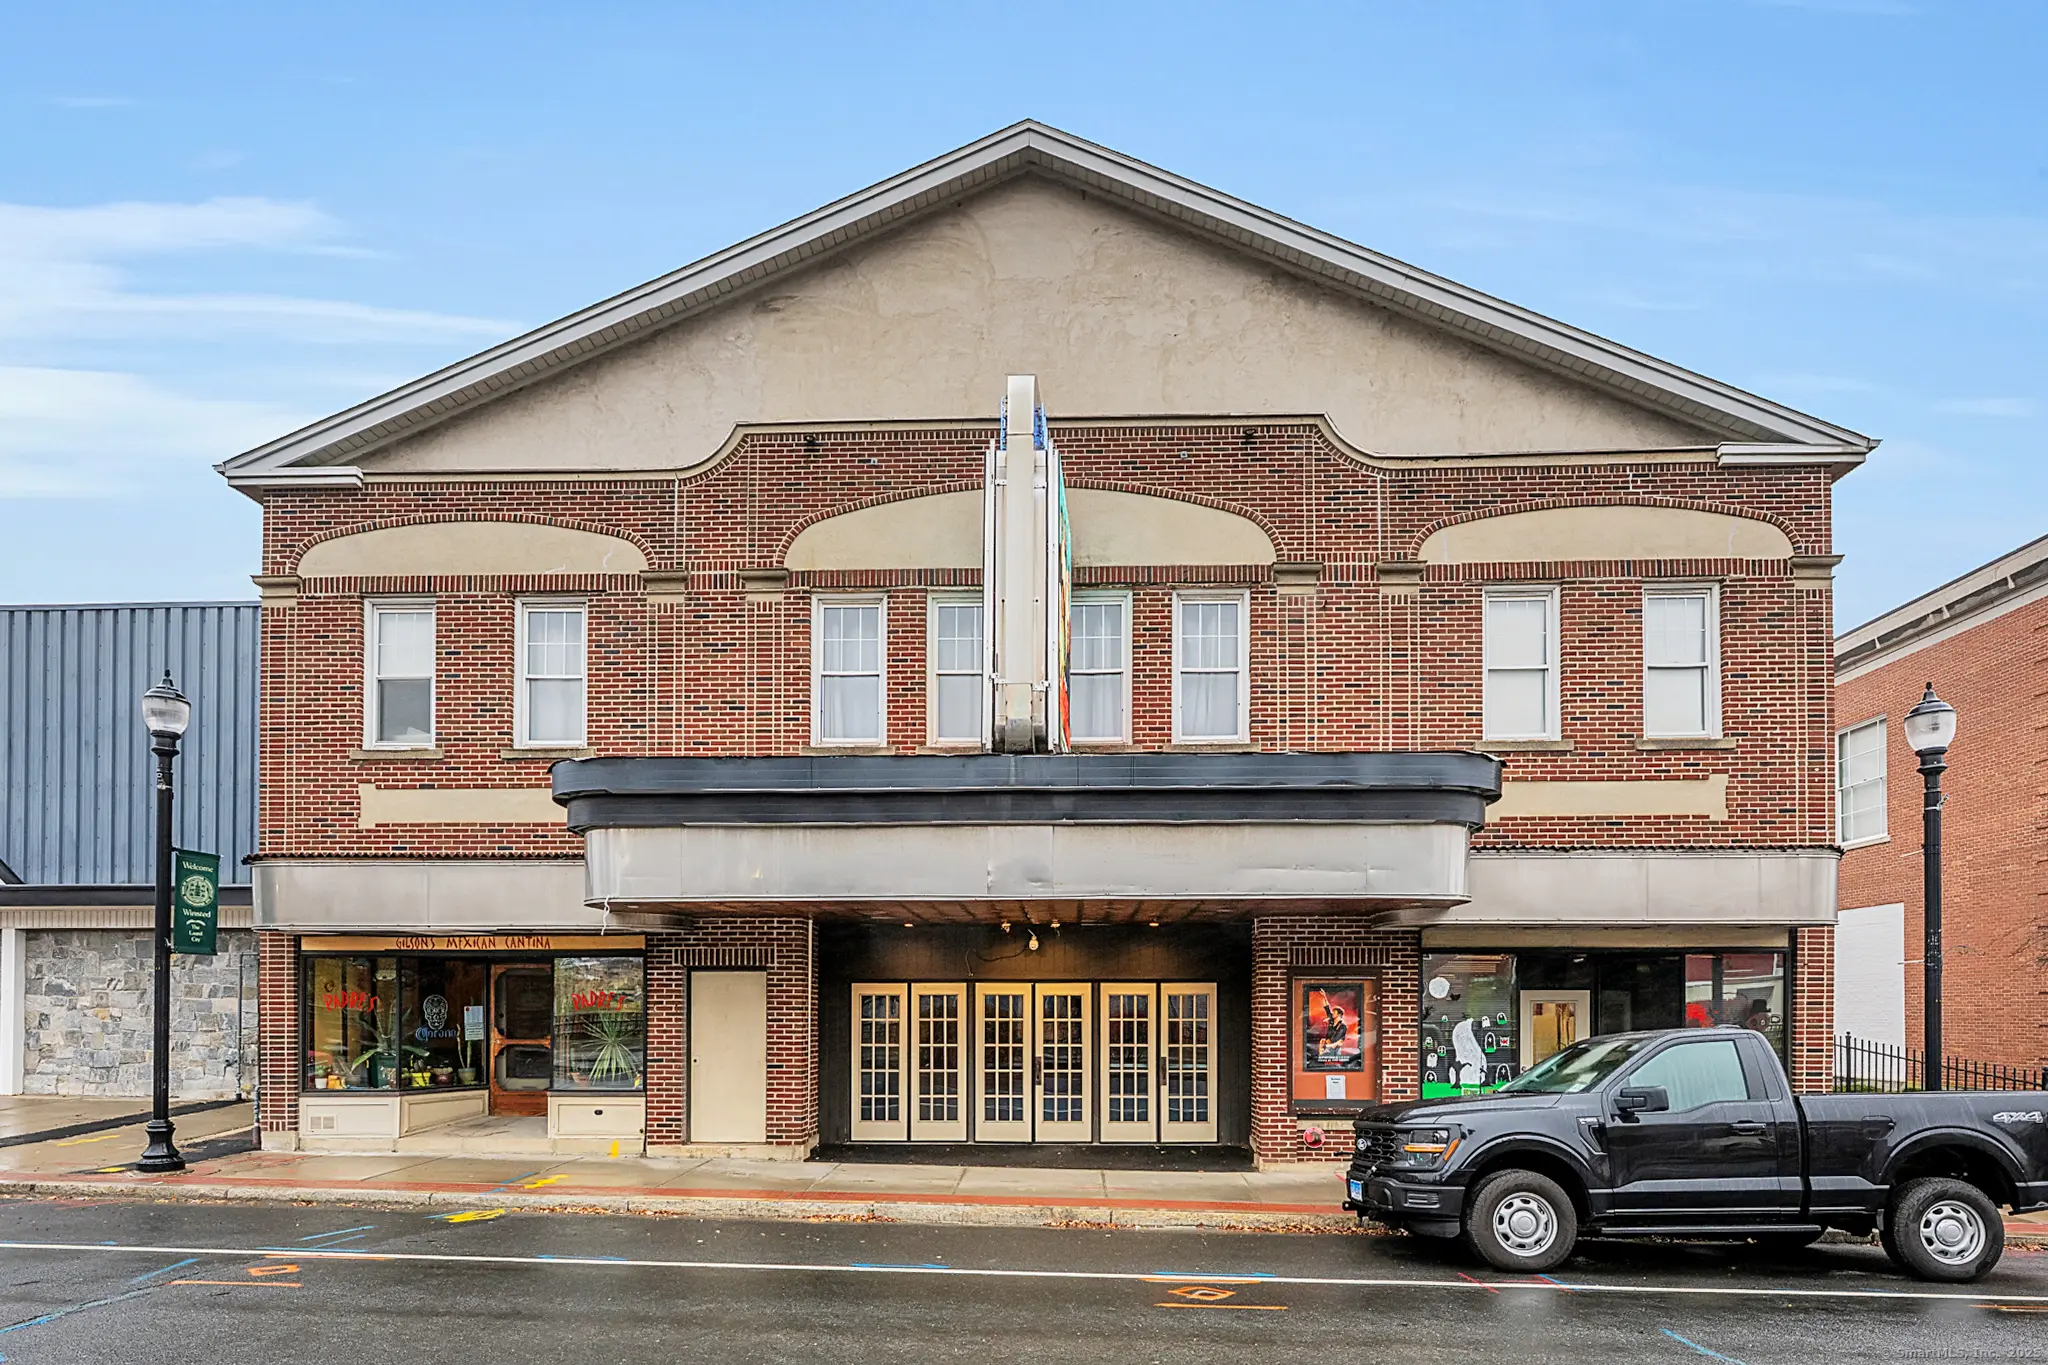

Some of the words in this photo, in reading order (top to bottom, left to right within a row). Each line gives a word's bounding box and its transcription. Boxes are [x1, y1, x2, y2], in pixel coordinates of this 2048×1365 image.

[182, 861, 214, 872] Welcome
[182, 908, 211, 918] Winsted
[416, 1027, 457, 1042] Corona
